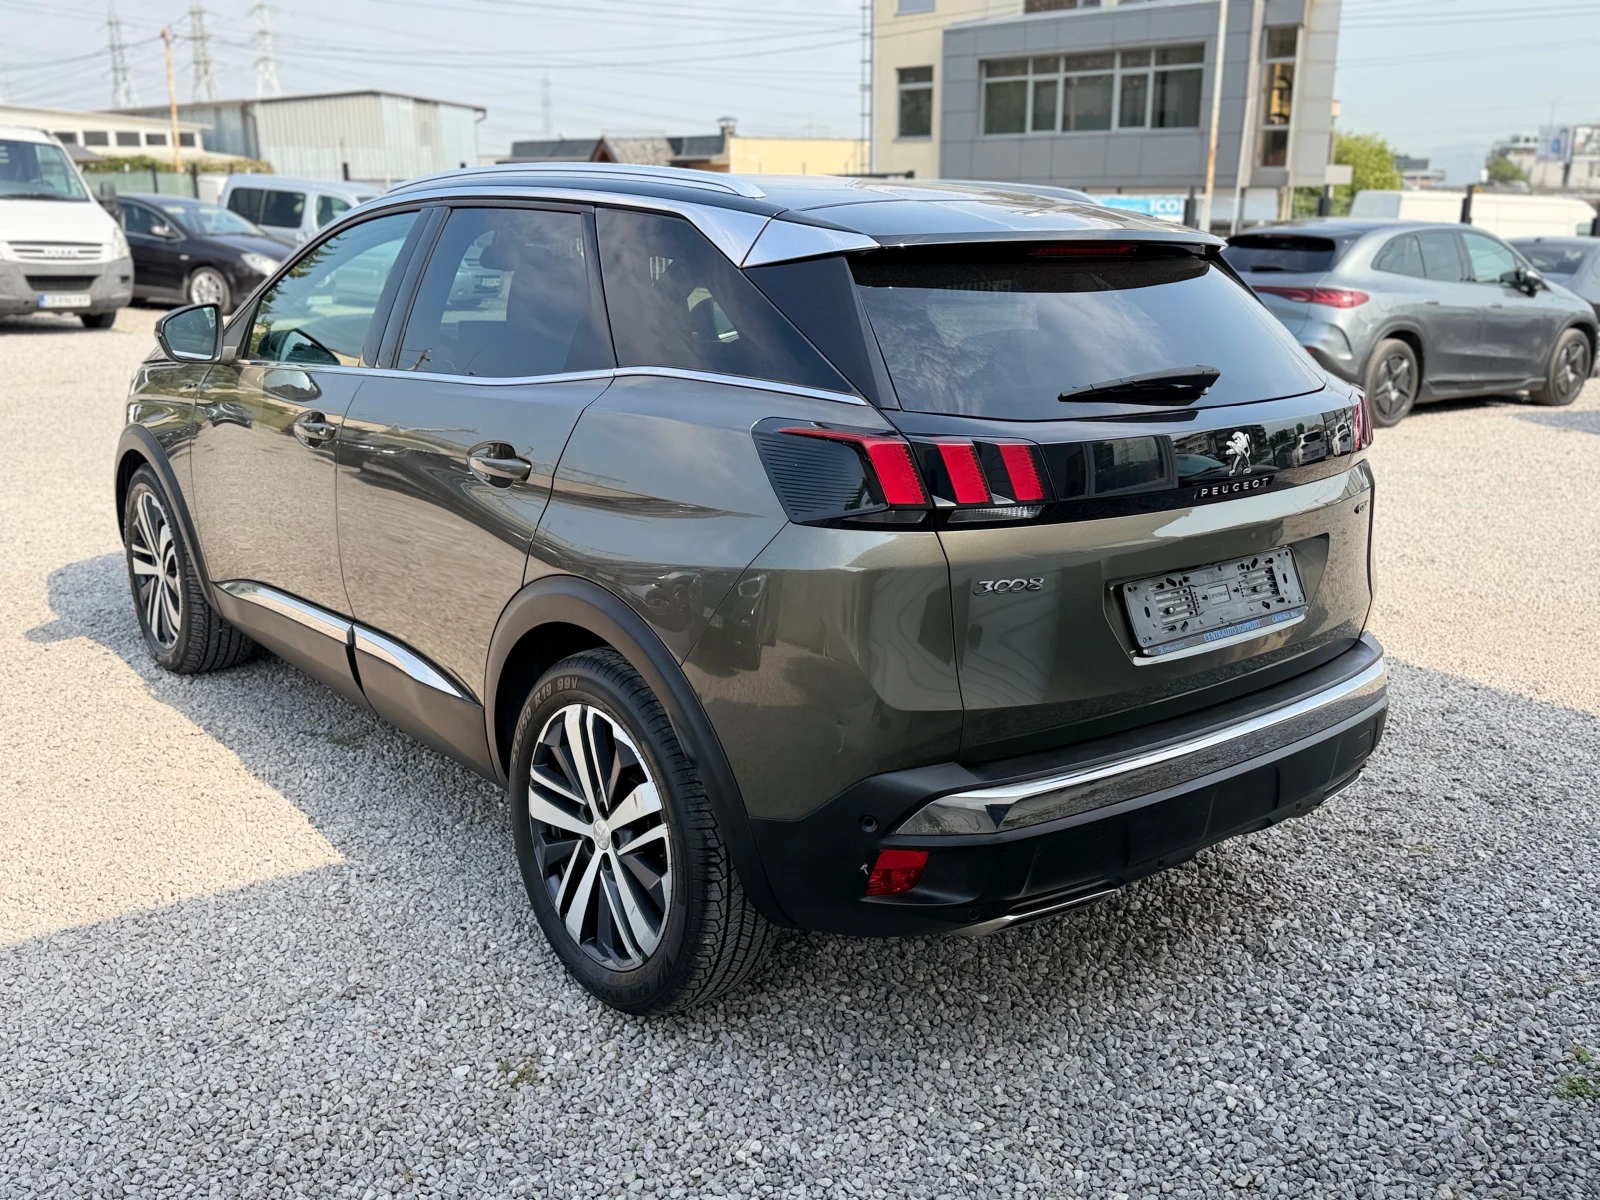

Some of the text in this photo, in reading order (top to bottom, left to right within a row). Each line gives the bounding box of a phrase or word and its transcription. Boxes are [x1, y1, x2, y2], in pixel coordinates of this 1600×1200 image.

[1200, 478, 1269, 497] PEUGEOT
[973, 577, 1045, 596] 3008
[534, 682, 552, 708] R19
[557, 676, 579, 691] 99V
